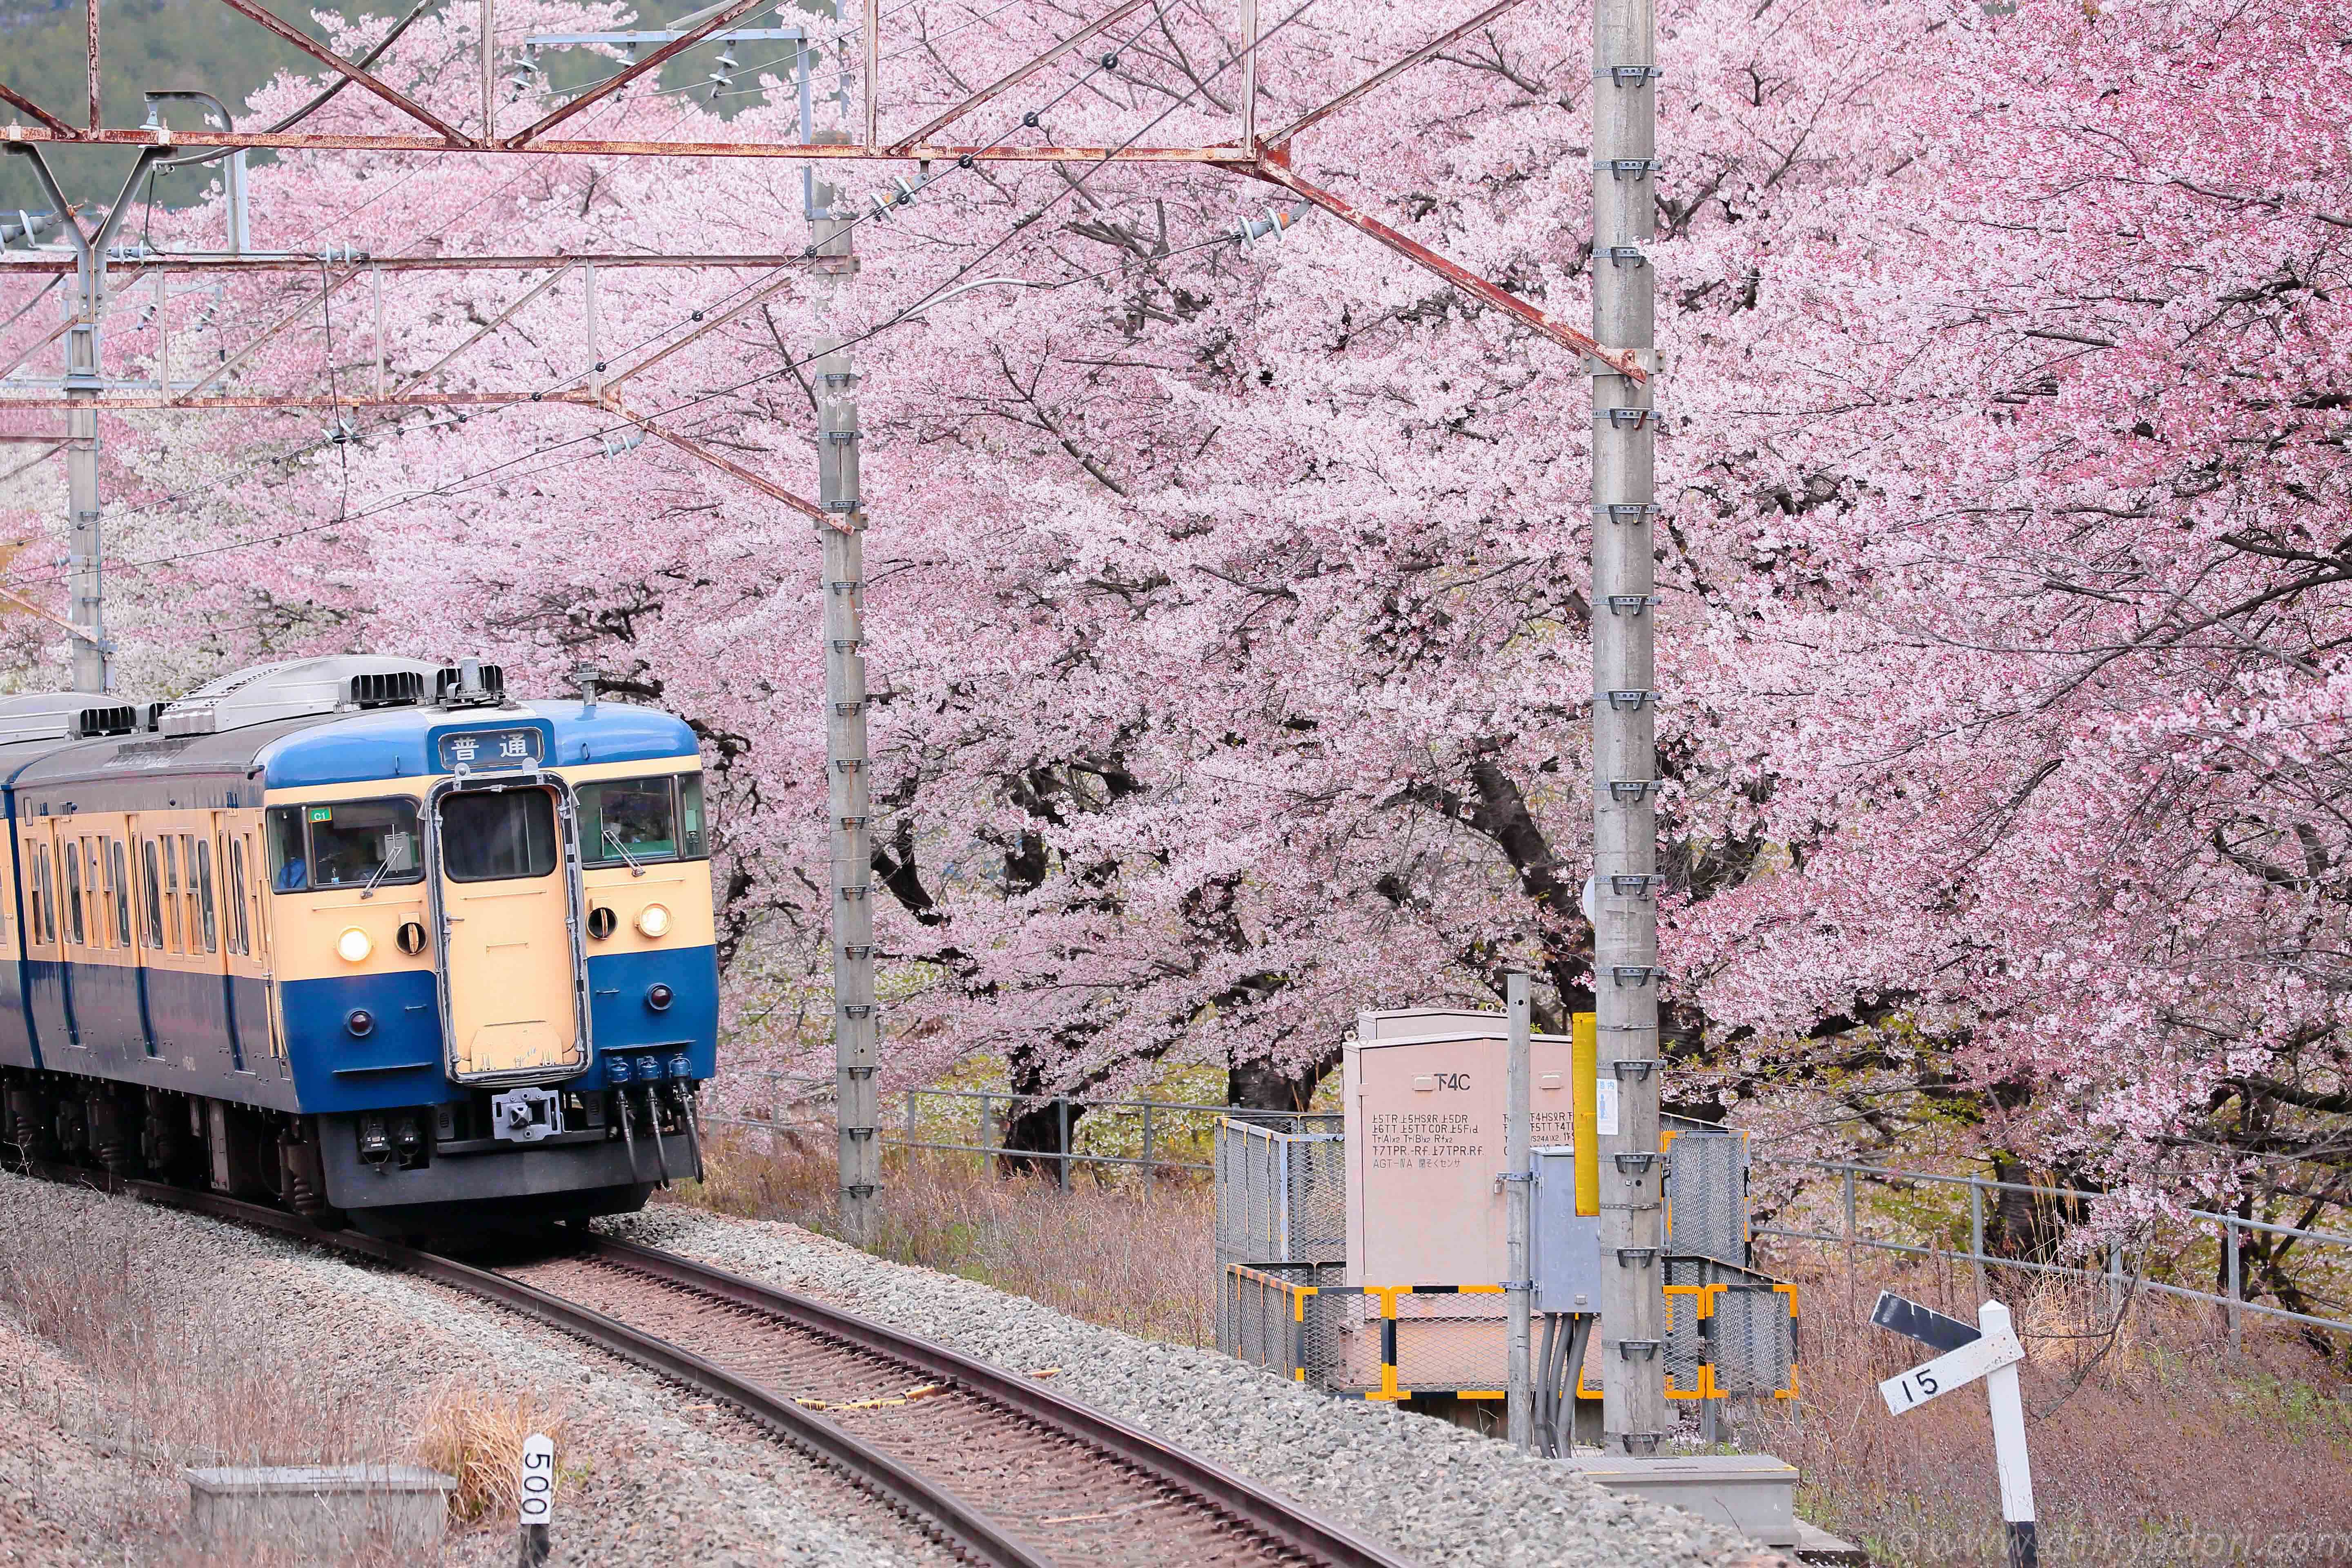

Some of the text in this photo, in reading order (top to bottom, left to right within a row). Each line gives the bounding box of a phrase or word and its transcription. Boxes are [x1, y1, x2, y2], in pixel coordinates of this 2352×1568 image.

[451, 733, 528, 760] 普通
[314, 812, 325, 820] C1
[1902, 1369, 1938, 1403] 15
[522, 1453, 550, 1514] 500
